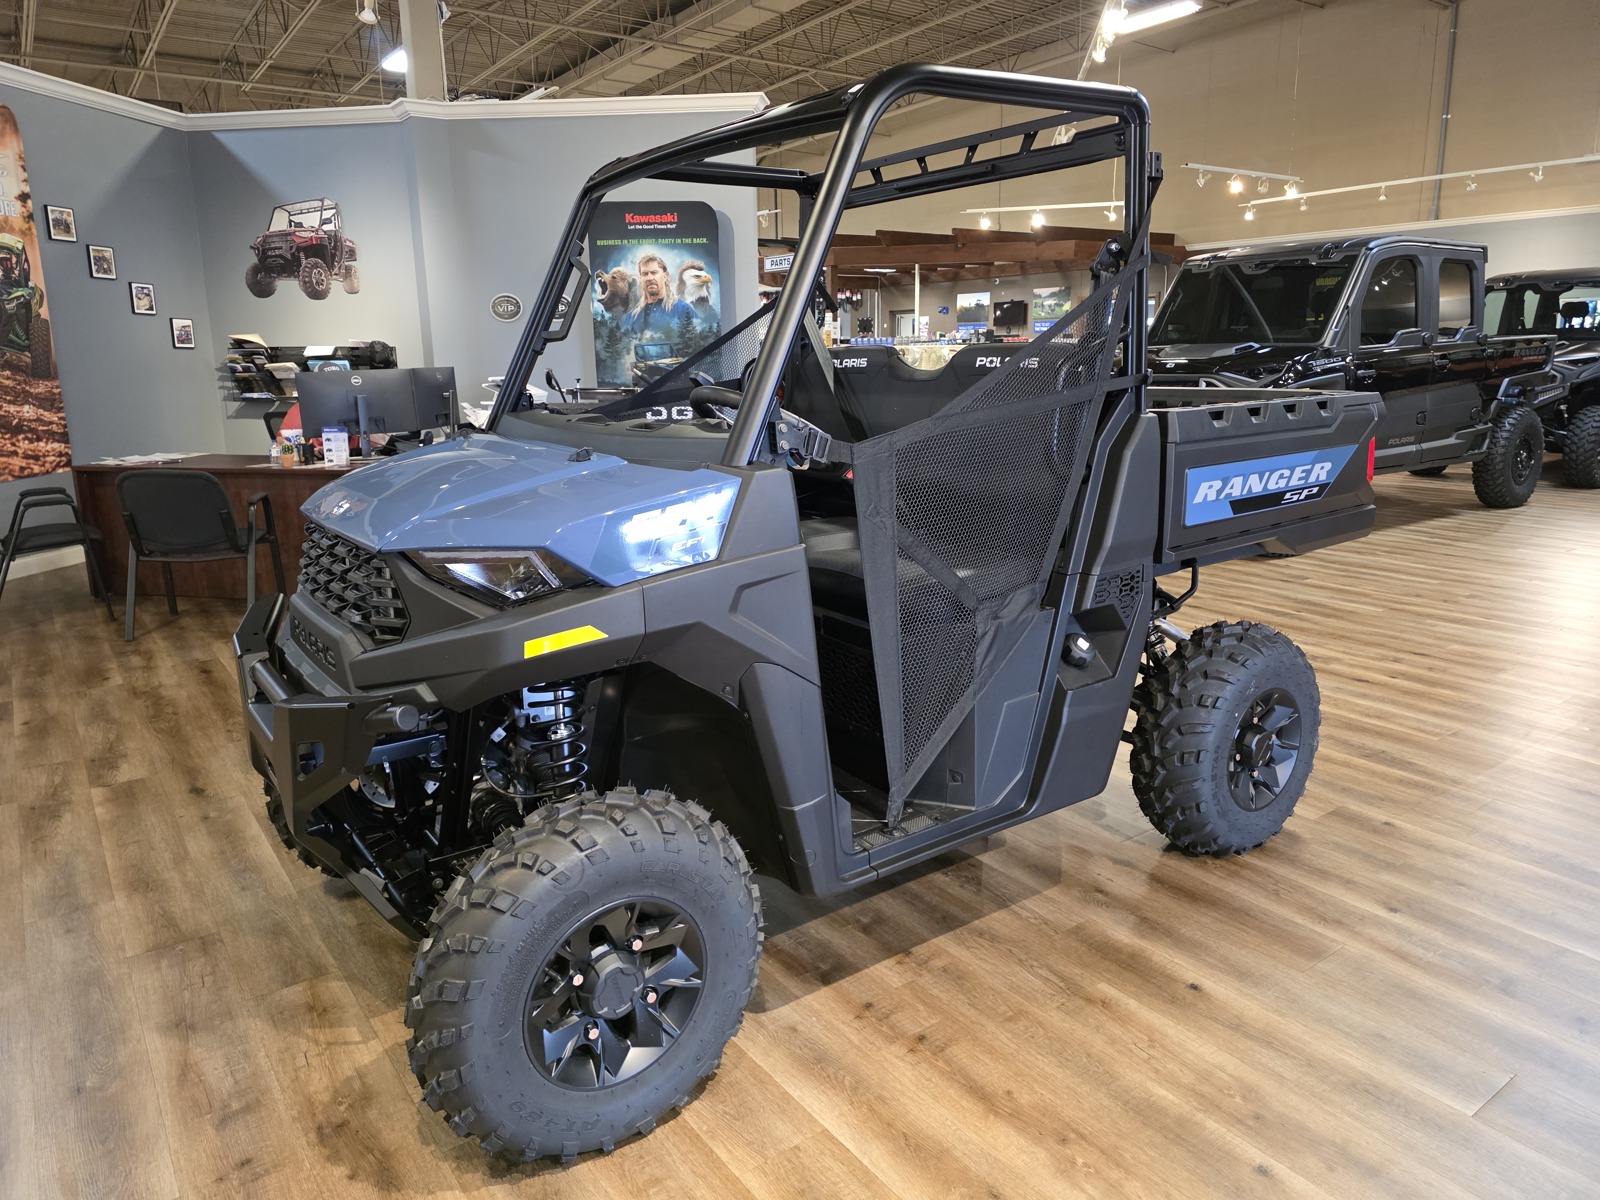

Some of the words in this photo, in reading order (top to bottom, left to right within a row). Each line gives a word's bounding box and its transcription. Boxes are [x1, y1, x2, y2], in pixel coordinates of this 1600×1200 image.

[625, 212, 678, 223] Kawasaki
[770, 257, 791, 267] PARTS
[497, 303, 515, 312] VIP
[1513, 346, 1547, 358] RANGER
[1388, 436, 1416, 446] POLARIS
[1192, 461, 1333, 505] RANGER
[1281, 486, 1320, 504] SP
[640, 860, 728, 908] CARLSTAR
[507, 1101, 602, 1135] AT489
